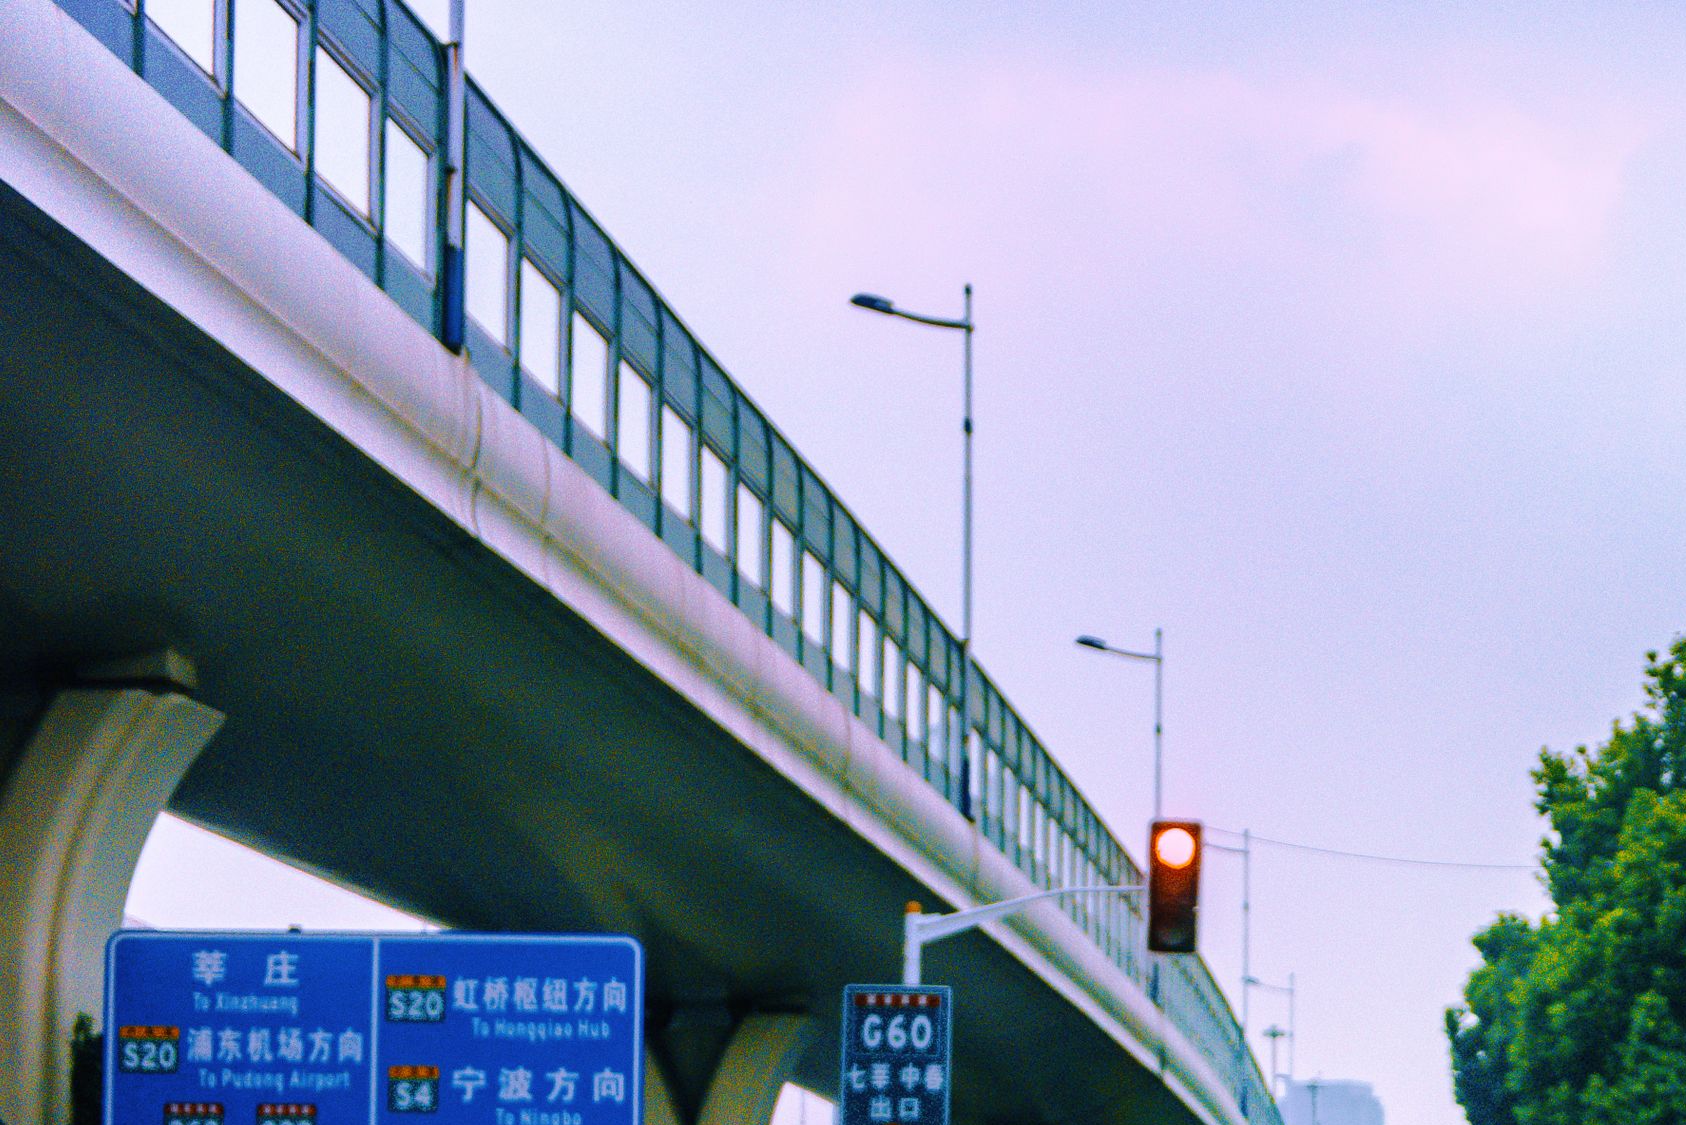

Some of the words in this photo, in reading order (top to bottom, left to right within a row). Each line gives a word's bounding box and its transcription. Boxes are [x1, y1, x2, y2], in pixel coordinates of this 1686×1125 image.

[191, 950, 300, 987] 莘庄
[193, 993, 211, 1011] To
[214, 992, 299, 1016] Xinzhuang
[389, 992, 444, 1019] S20
[453, 977, 627, 1013] 虹桥枢纽方向
[472, 1018, 491, 1037] To
[495, 1018, 574, 1041] Hongqiao
[578, 1018, 610, 1037] Hub
[862, 1013, 932, 1049] G60
[123, 1042, 176, 1070] S20
[187, 1028, 363, 1063] 浦东机场方向
[199, 1069, 218, 1088] To
[221, 1068, 285, 1092] Pudong
[289, 1069, 350, 1092] Airport
[453, 1067, 625, 1103] 宁波方向
[396, 1082, 434, 1109] S4
[870, 1096, 919, 1119] 出口
